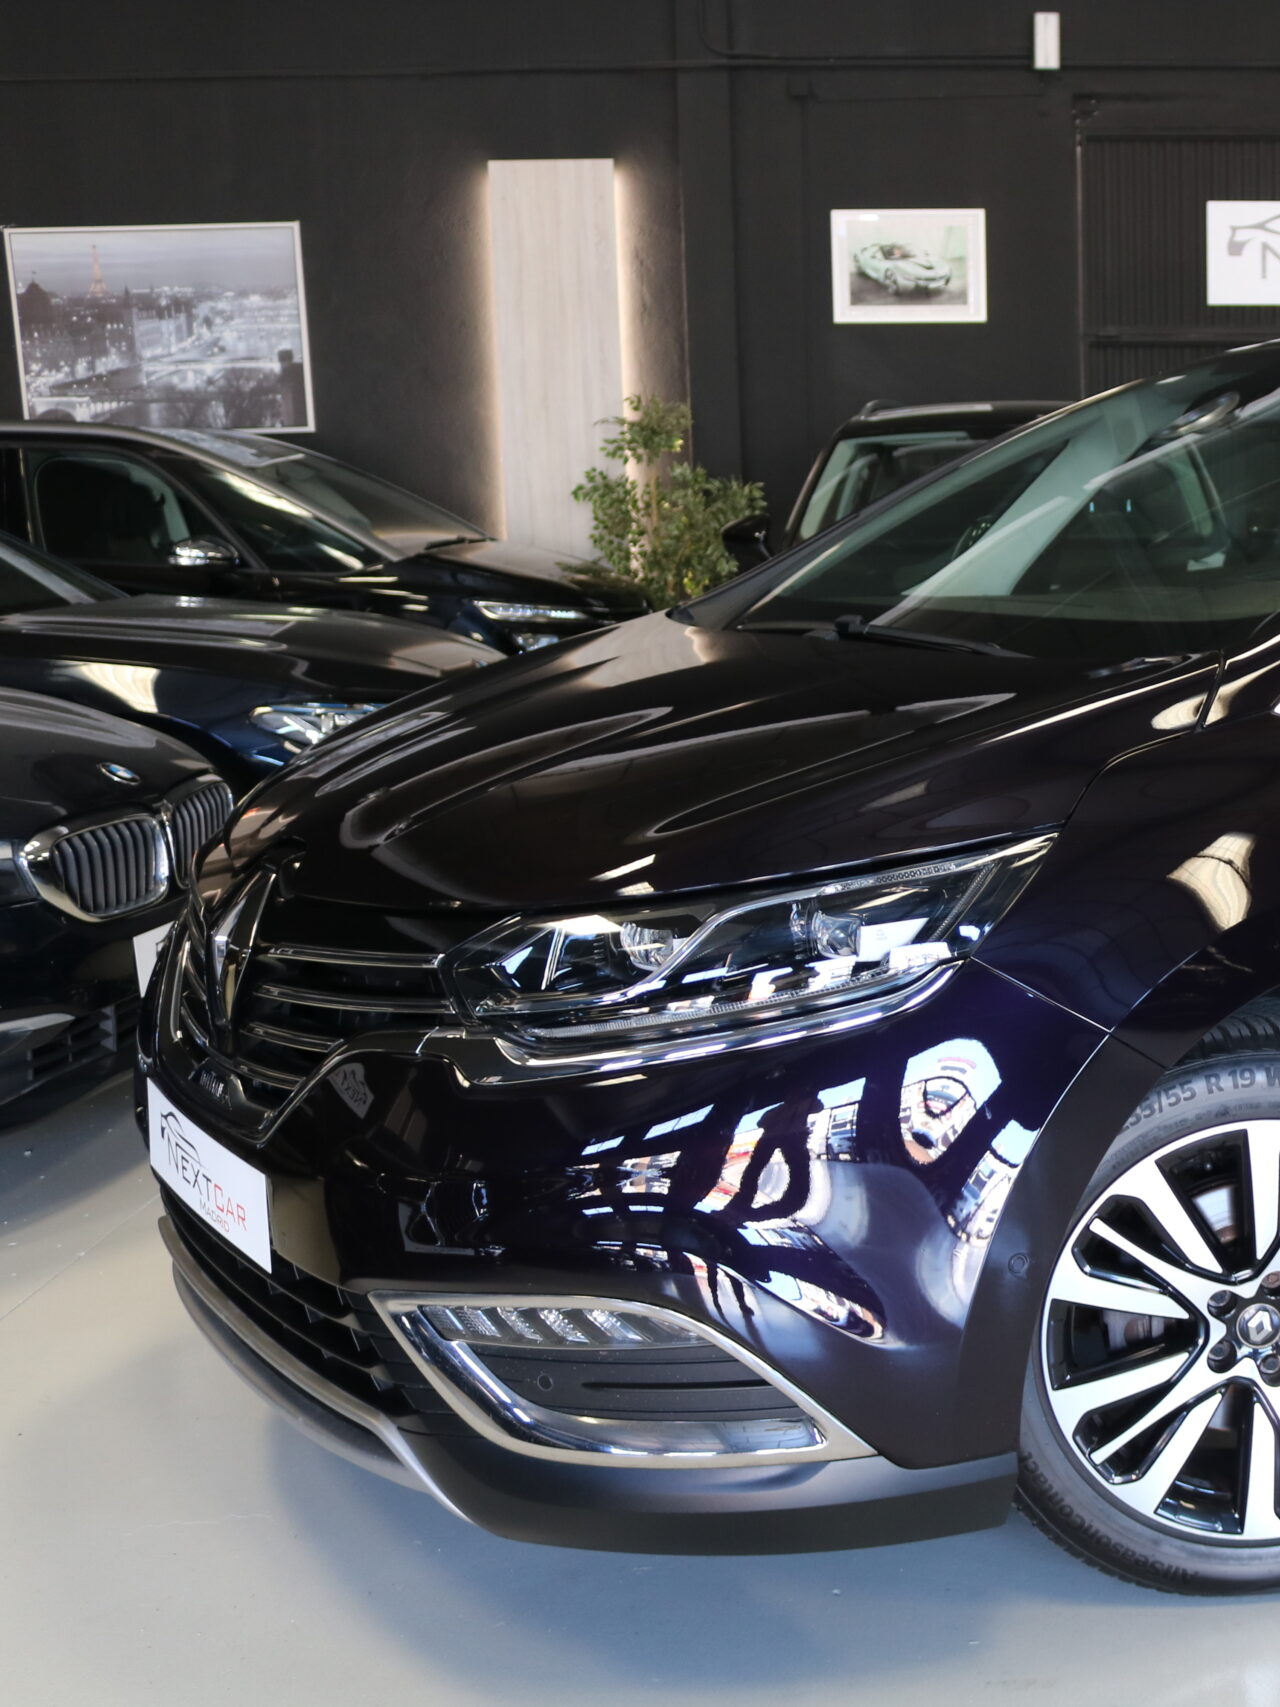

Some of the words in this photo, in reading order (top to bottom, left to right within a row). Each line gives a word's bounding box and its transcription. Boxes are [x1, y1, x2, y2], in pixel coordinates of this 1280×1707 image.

[1123, 1080, 1197, 1131] 35/55
[1204, 1072, 1225, 1095] R
[1228, 1068, 1256, 1090] 19
